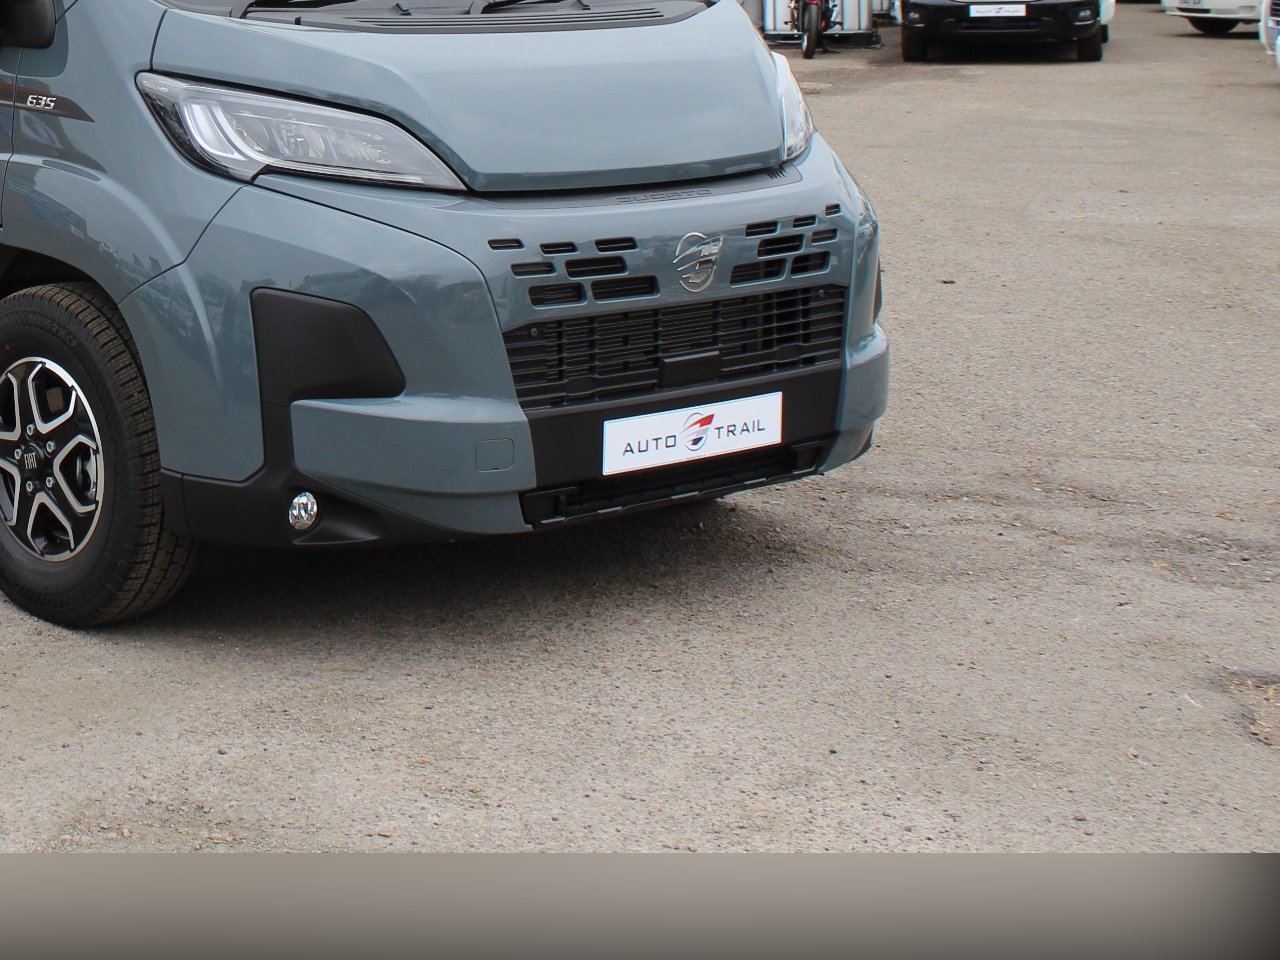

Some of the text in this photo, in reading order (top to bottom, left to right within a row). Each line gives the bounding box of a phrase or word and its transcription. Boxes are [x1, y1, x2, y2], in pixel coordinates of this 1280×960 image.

[26, 94, 57, 110] 635
[615, 188, 713, 204] DUCATO
[622, 419, 766, 456] AUTO TRAIL
[23, 452, 38, 470] FIAT
